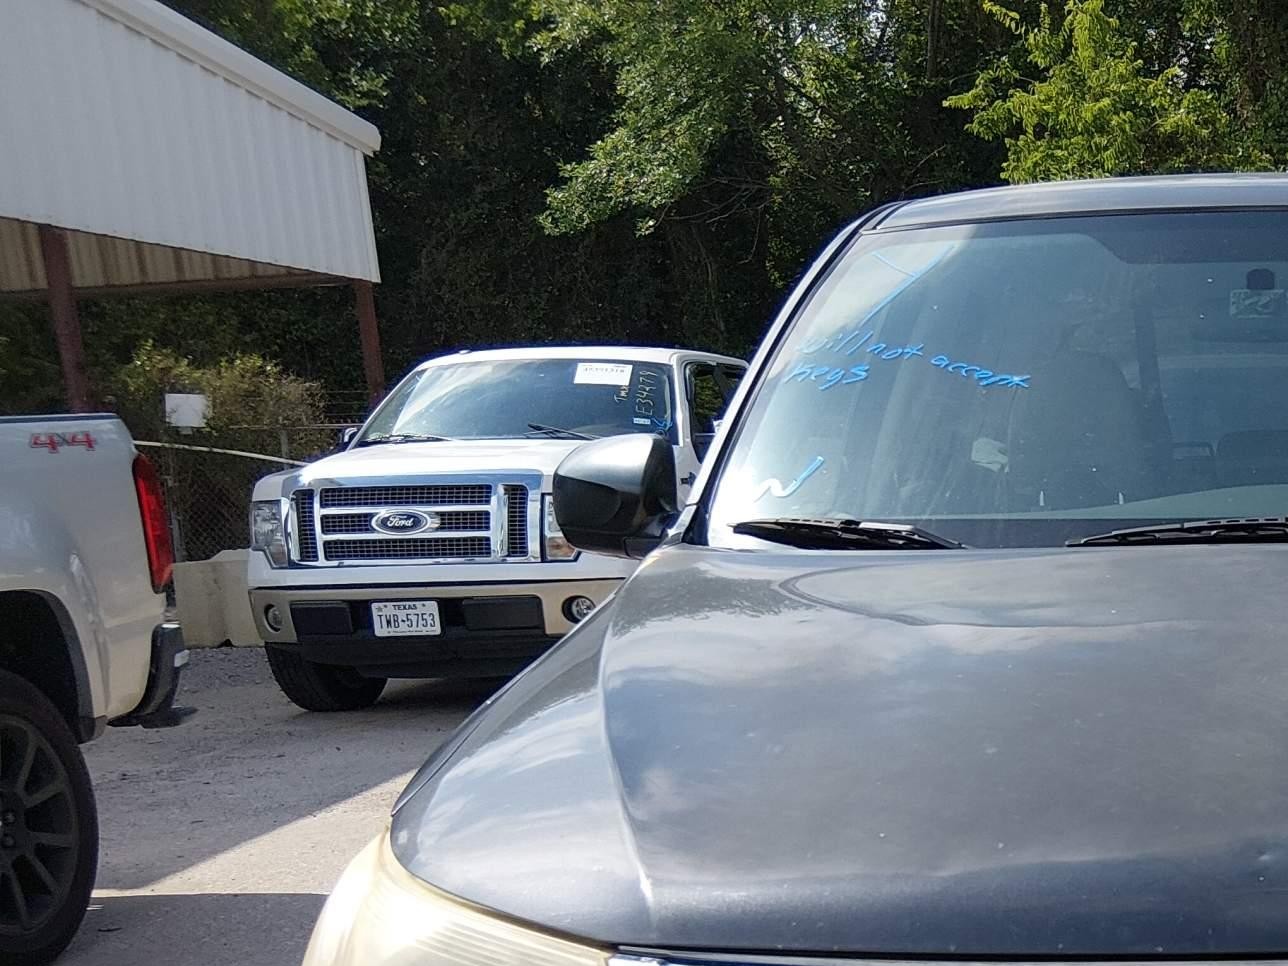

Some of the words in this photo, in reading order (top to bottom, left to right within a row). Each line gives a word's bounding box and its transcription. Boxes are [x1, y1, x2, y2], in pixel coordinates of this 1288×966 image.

[865, 343, 925, 360] not
[387, 514, 415, 527] Ford
[392, 603, 418, 611] TEXAS
